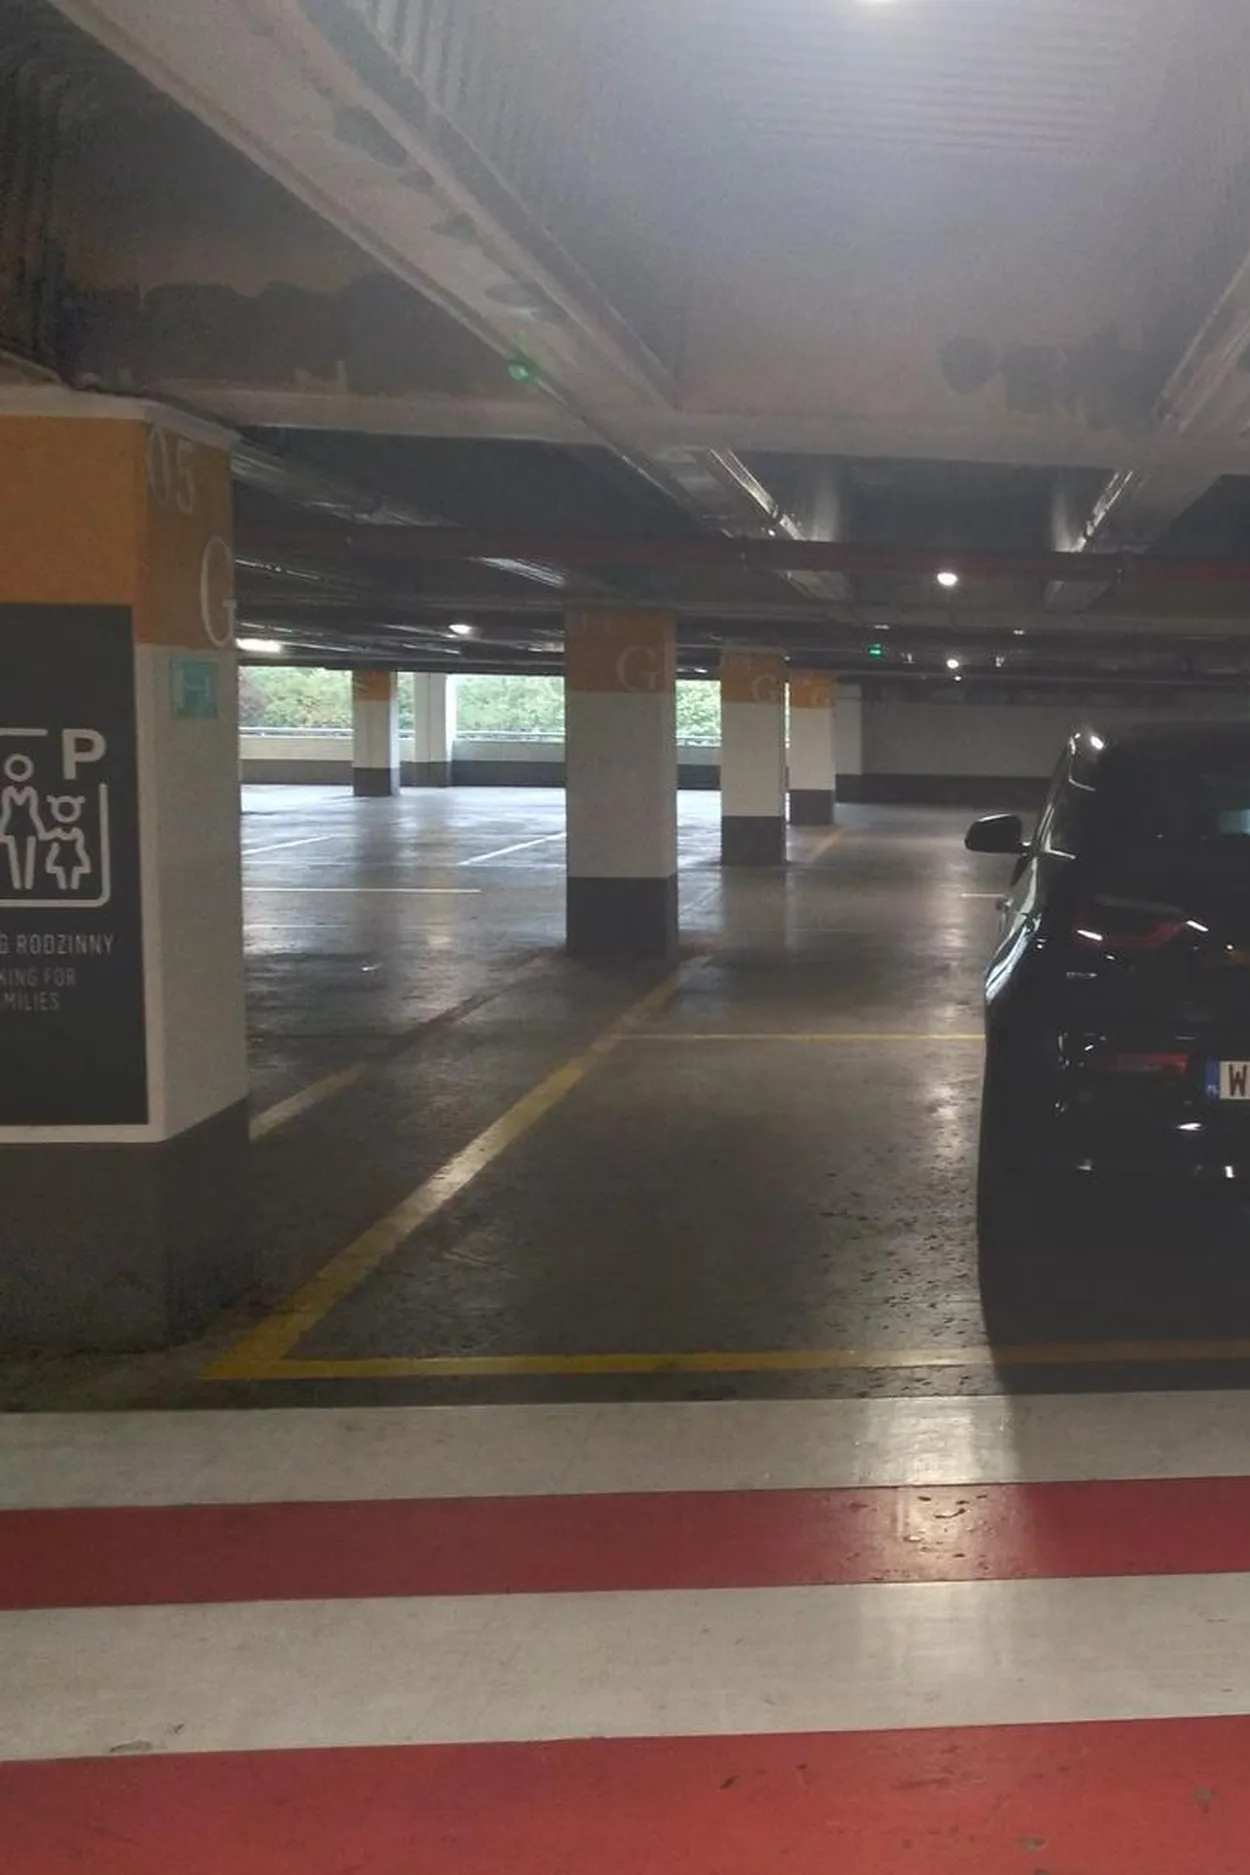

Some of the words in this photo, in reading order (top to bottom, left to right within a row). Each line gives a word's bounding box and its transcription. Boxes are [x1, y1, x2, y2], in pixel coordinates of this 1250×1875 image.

[200, 533, 237, 648] G
[615, 644, 660, 692] G
[751, 674, 781, 703] G
[62, 729, 107, 780] P
[16, 933, 115, 955] RODZINNY
[43, 966, 77, 986] FOR
